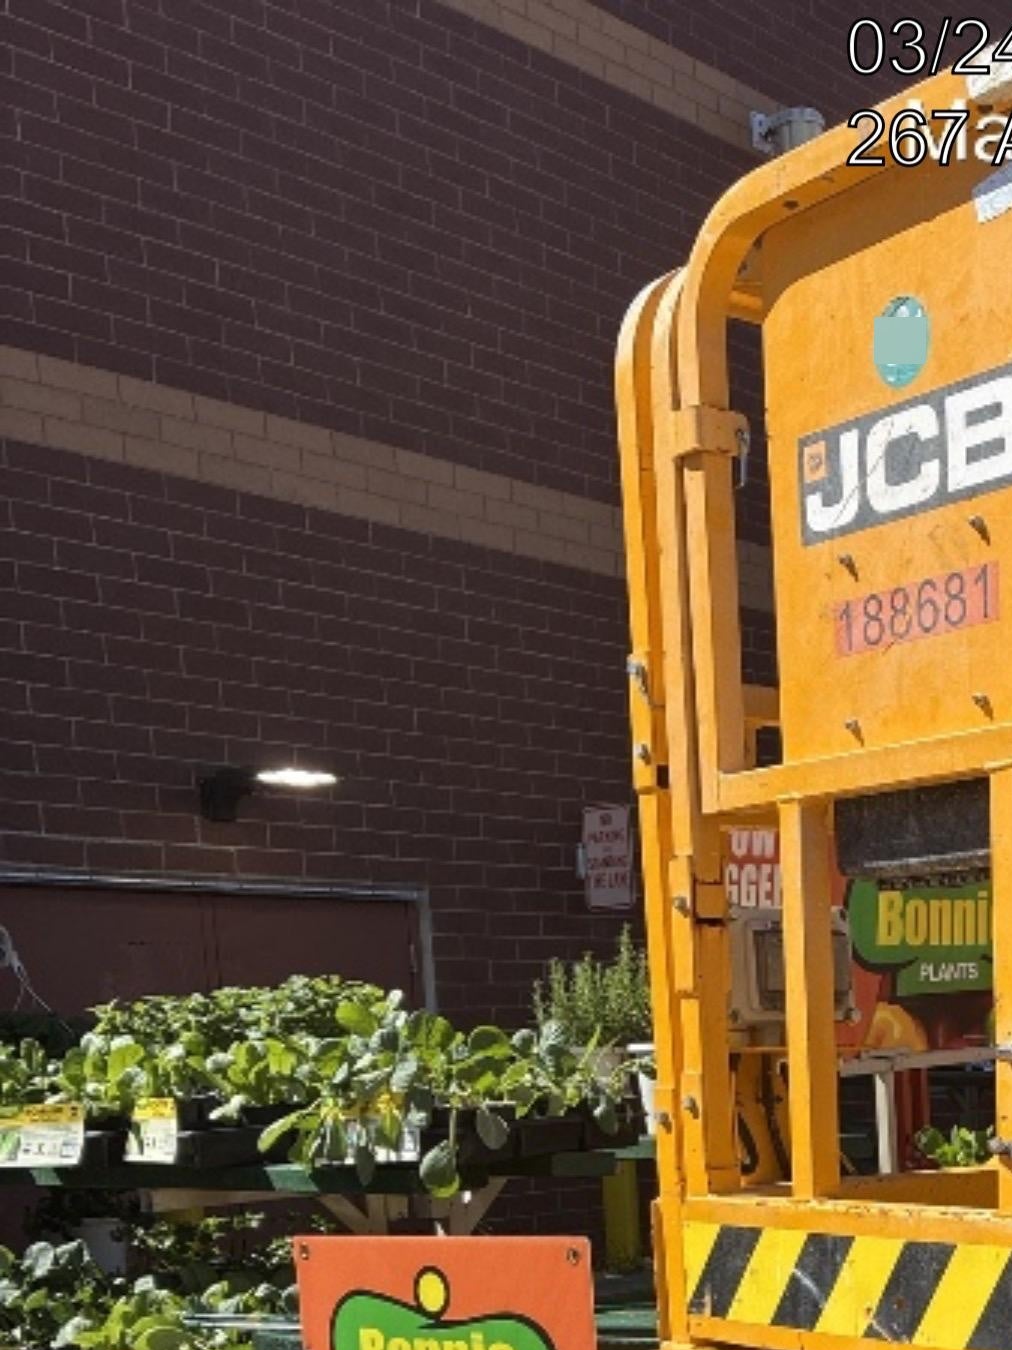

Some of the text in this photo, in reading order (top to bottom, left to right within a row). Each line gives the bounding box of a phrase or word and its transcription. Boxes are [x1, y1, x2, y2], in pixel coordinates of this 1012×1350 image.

[839, 563, 991, 653] 188681
[876, 890, 990, 945] Bonni
[920, 962, 978, 981] PLANTS
